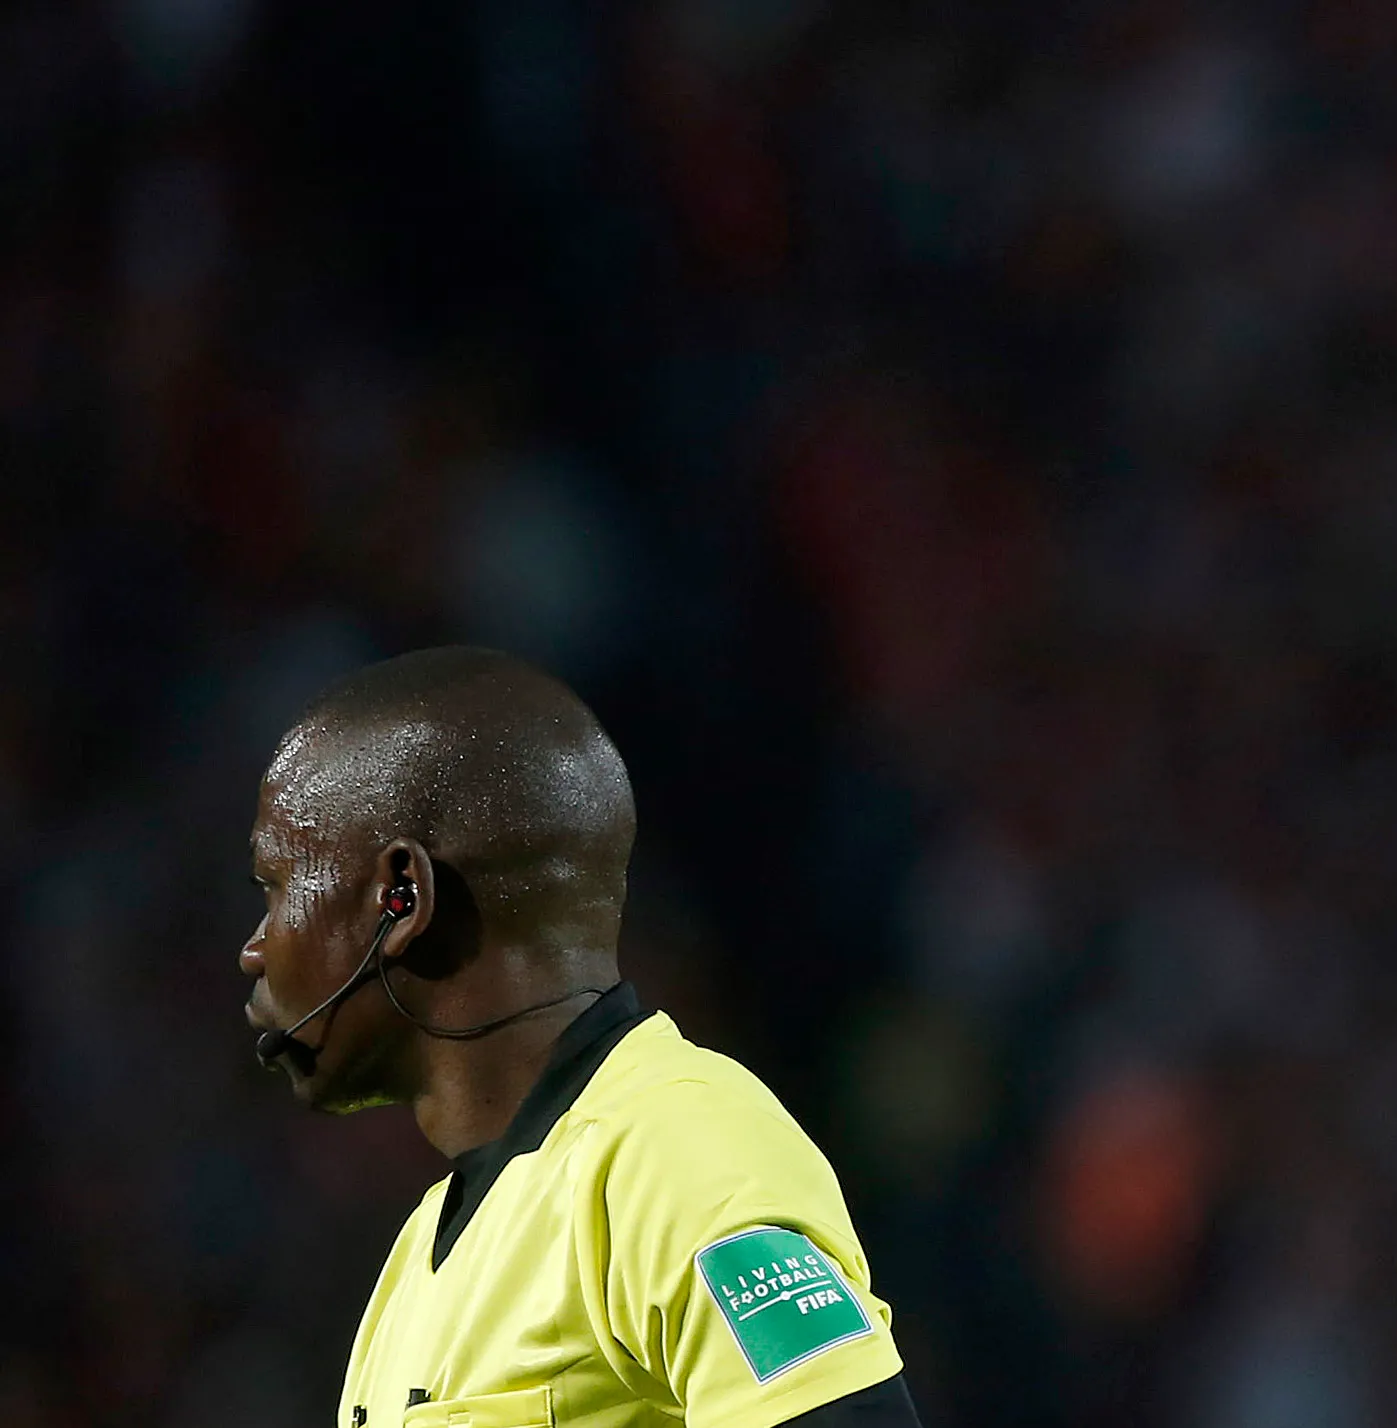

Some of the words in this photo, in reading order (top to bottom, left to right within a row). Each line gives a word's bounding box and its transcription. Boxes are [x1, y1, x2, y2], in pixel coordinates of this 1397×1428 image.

[721, 1254, 818, 1298] LIVING
[729, 1266, 827, 1312] FOOTBALL
[795, 1288, 844, 1315] FIFA
